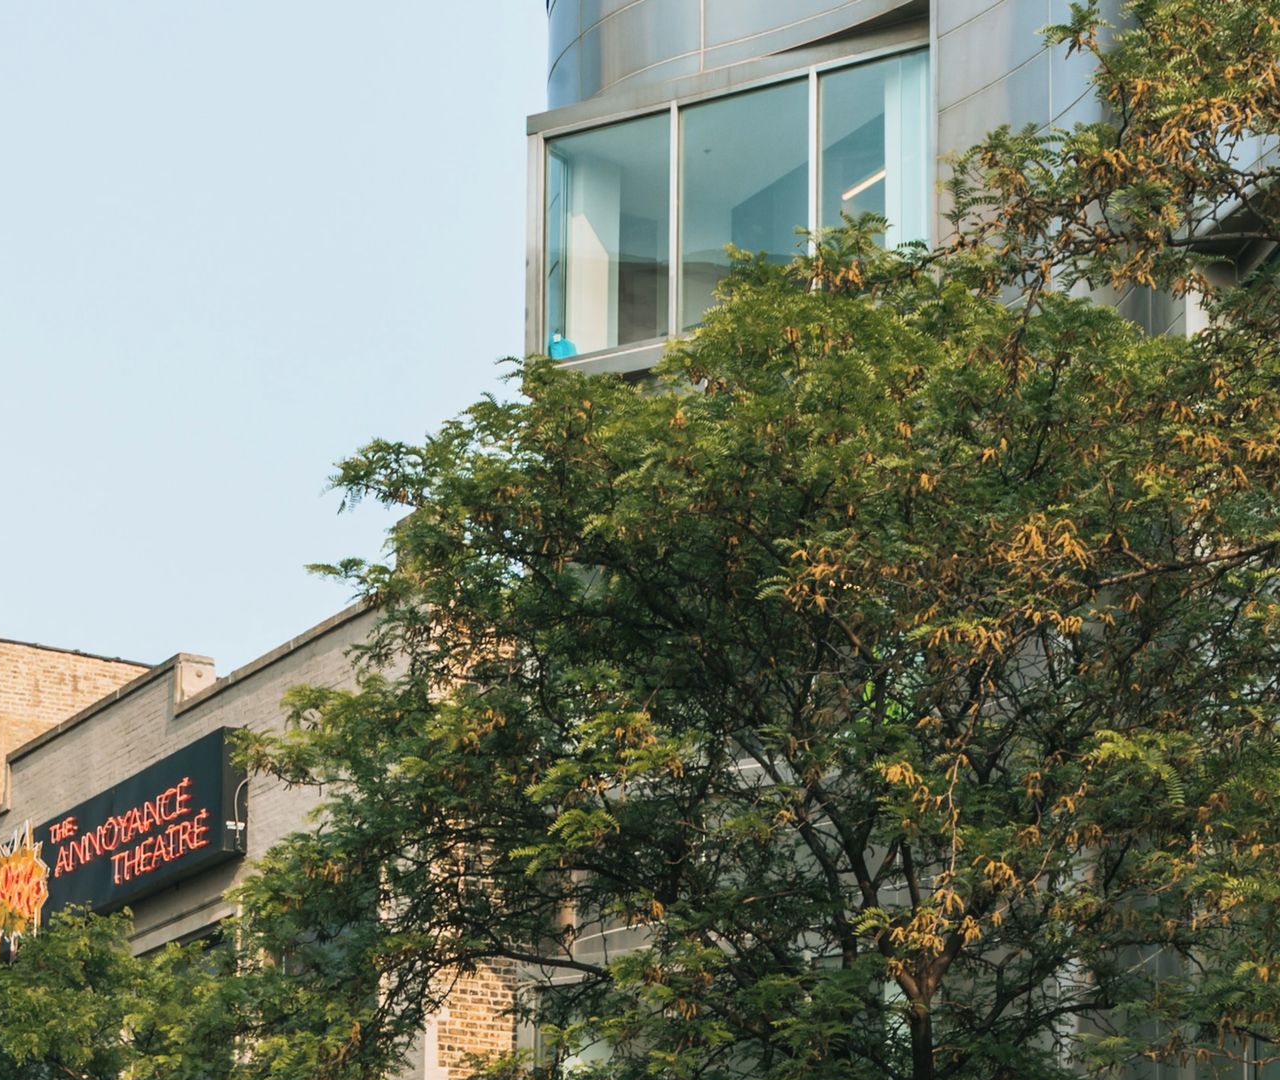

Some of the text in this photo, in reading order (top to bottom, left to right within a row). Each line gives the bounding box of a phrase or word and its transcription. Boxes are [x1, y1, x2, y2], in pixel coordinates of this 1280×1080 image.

[49, 816, 78, 844] THE
[54, 776, 193, 878] ANNOYANCE
[111, 808, 210, 885] THEATRE
